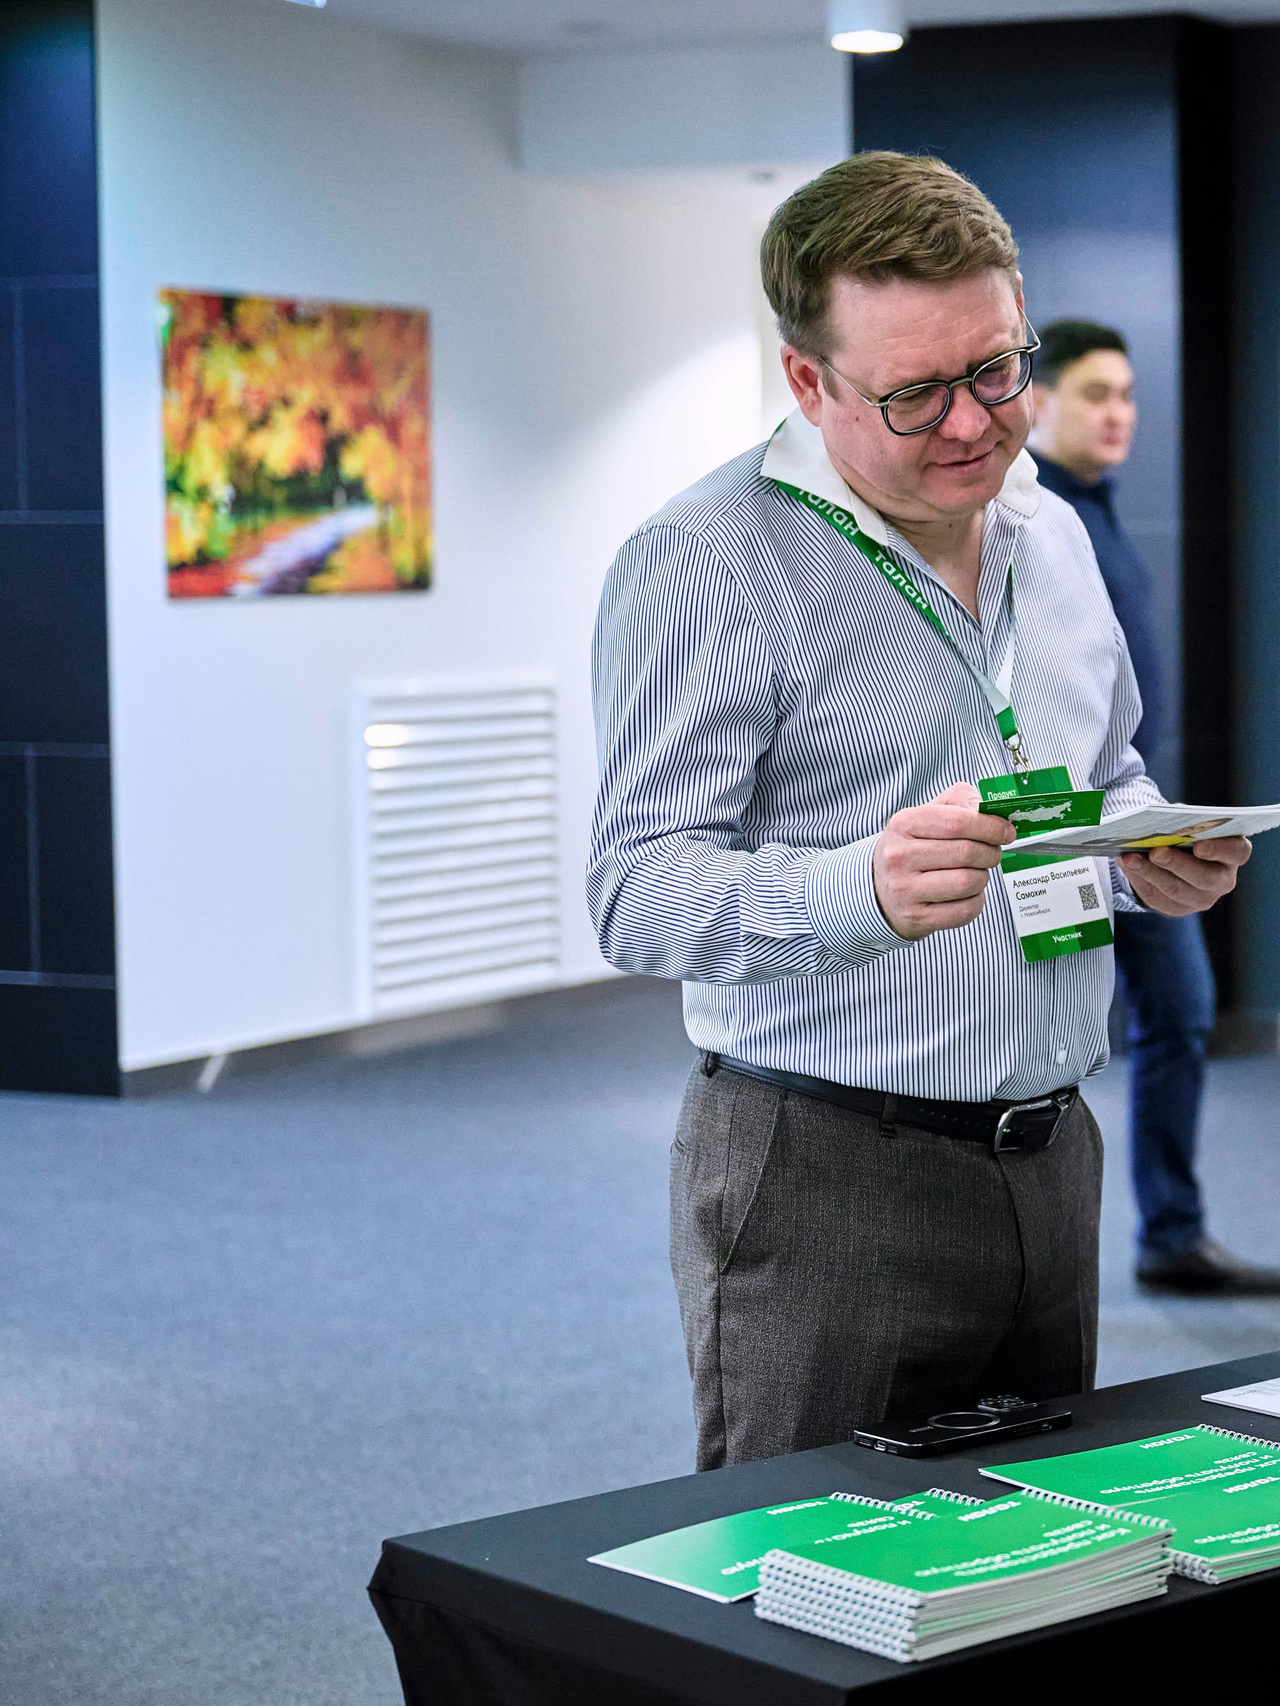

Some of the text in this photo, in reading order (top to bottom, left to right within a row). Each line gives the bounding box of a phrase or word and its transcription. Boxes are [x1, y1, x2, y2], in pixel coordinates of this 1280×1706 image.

[874, 550, 929, 610] талан
[987, 789, 1017, 801] Продукт
[1012, 867, 1090, 889] Александр Васильевич
[1015, 888, 1048, 901] Самохин
[1052, 931, 1083, 944] Участник
[1138, 1434, 1196, 1450] талан
[1214, 1452, 1258, 1464] связь
[1184, 1459, 1260, 1479] получать
[1099, 1477, 1183, 1495] обратную
[1133, 1466, 1255, 1495] предоставлять
[1222, 1476, 1280, 1494] талан
[765, 1501, 829, 1516] талан
[957, 1501, 1022, 1522] талан
[846, 1515, 895, 1528] связь
[1193, 1523, 1279, 1545] обратную
